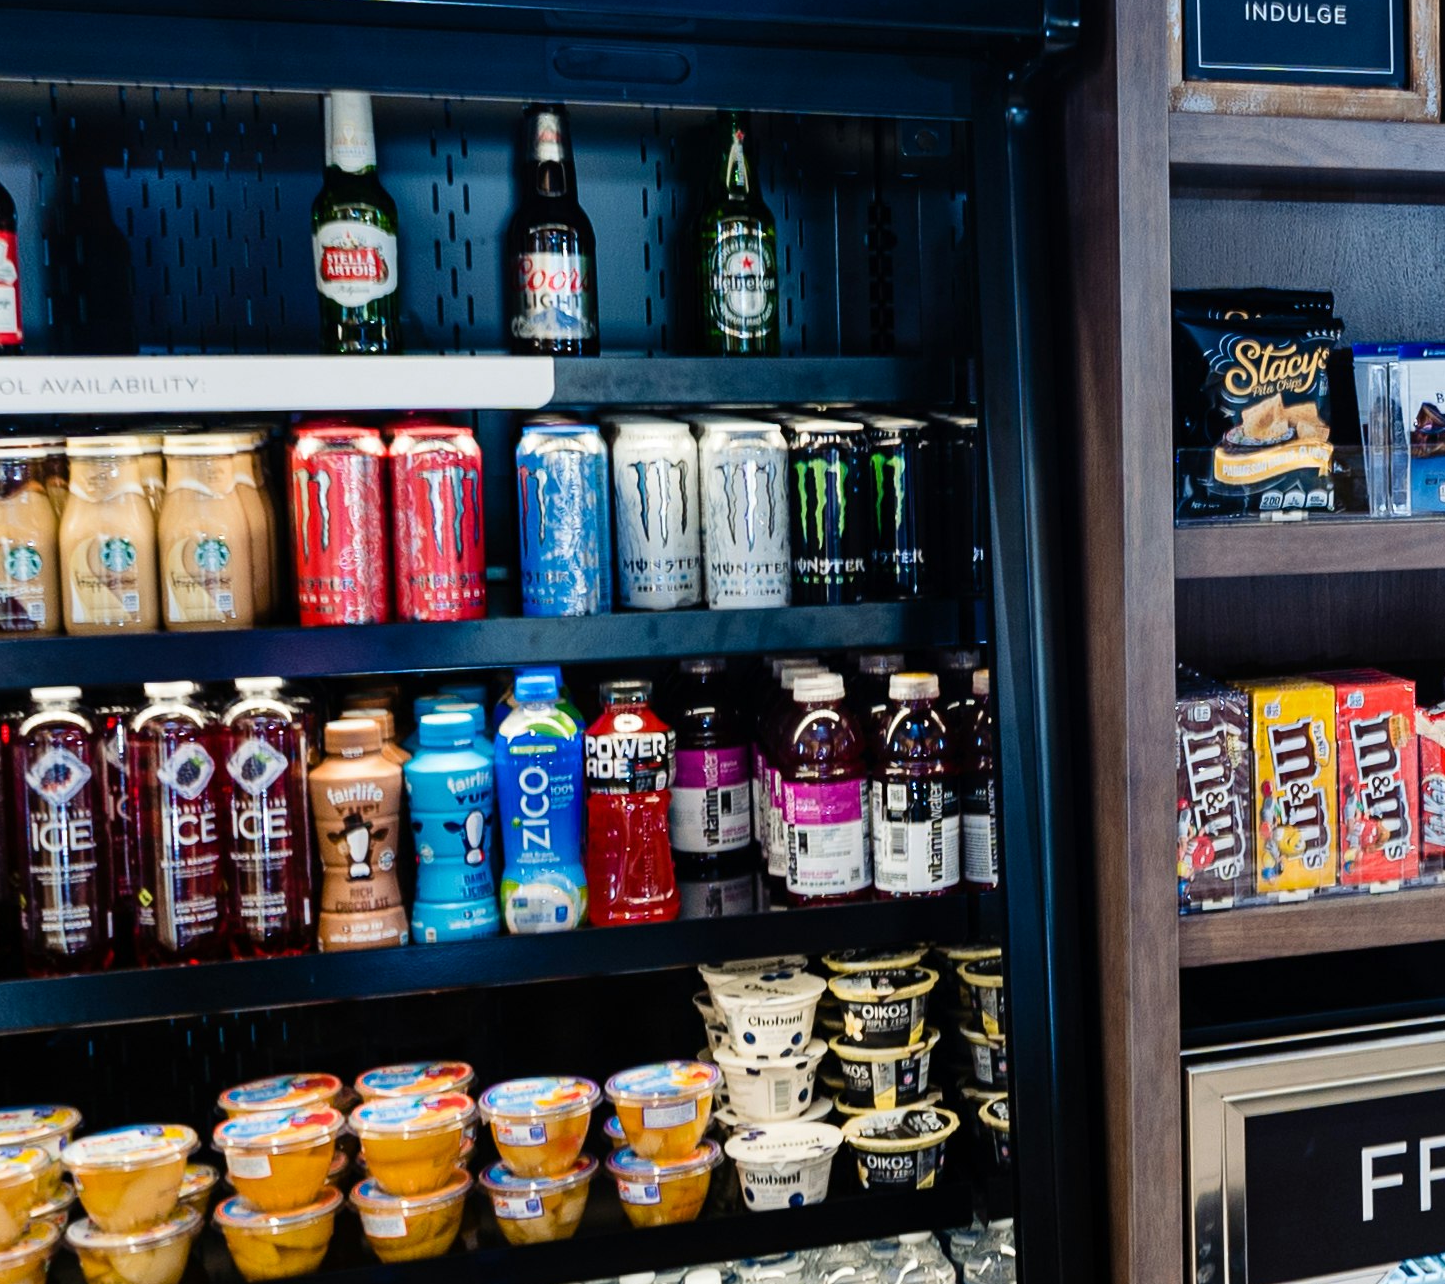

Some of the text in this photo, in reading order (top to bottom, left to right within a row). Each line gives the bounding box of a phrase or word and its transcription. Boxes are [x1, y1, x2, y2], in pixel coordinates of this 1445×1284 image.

[1244, 0, 1349, 26] INDULGE
[326, 249, 378, 266] STELLA
[326, 264, 378, 278] ARTOIS
[512, 254, 590, 293] Coors
[712, 275, 775, 294] Heineken
[523, 292, 583, 310] LIGHT
[1224, 339, 1330, 396] Stacy's
[1252, 379, 1303, 397] Pita Chips
[585, 732, 667, 760] POWER
[1312, 721, 1328, 761] PEANUT
[586, 758, 629, 779] ADE
[327, 783, 384, 806] fairlife
[517, 766, 551, 850] ZICO
[161, 812, 218, 846] ICE
[230, 807, 289, 840] ICE
[30, 818, 93, 852] ICE
[747, 1011, 804, 1028] Chobani
[861, 1004, 909, 1019] OIKOS
[866, 1156, 914, 1170] OIKOS
[745, 1171, 802, 1187] Chobani
